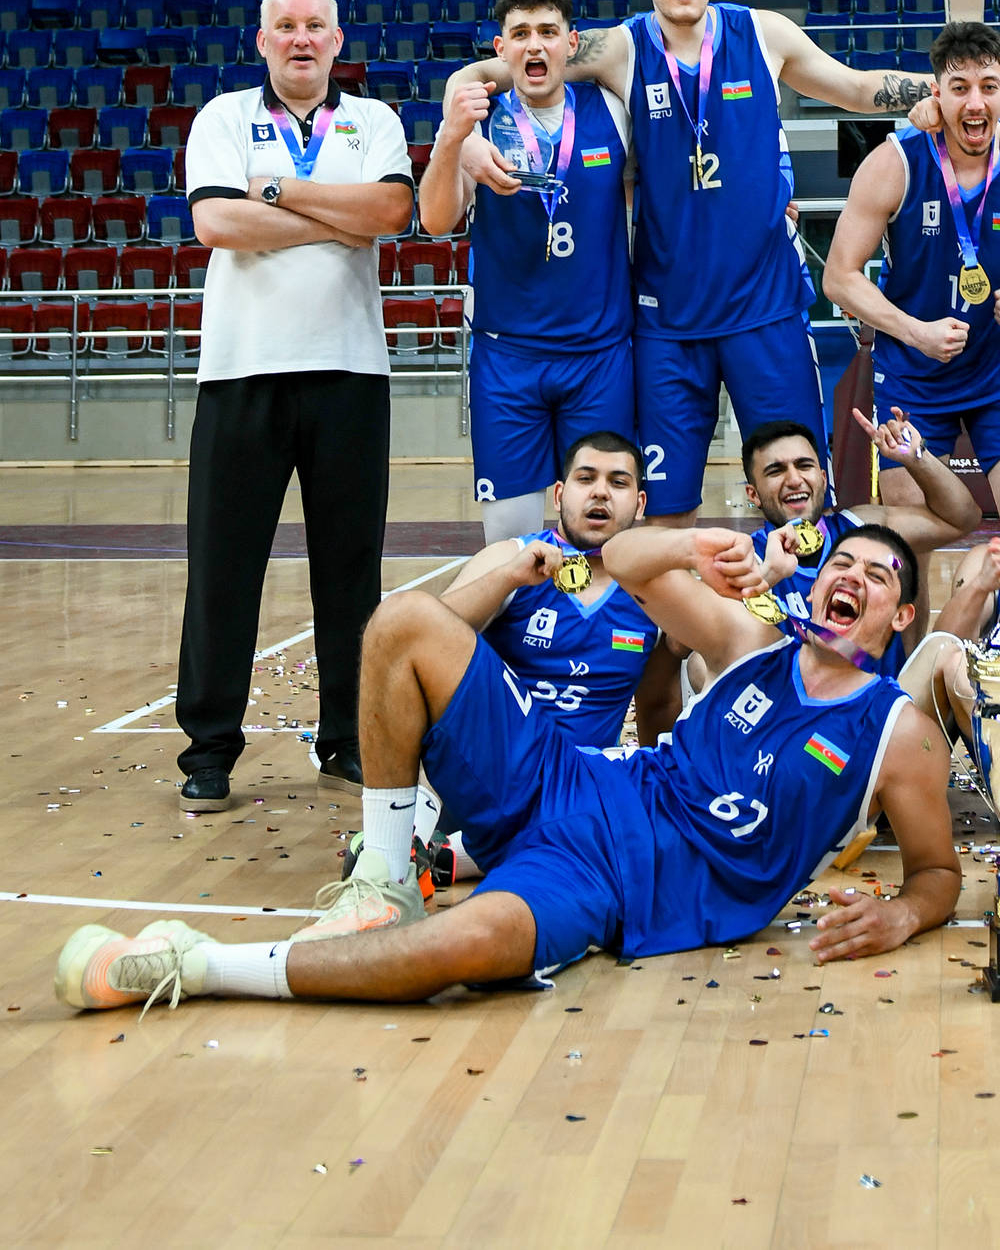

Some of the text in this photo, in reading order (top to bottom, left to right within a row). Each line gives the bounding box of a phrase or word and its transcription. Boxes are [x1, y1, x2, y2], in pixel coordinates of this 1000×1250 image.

[650, 108, 673, 120] AZTU
[688, 152, 723, 191] 12
[551, 221, 575, 258] 8
[922, 226, 941, 236] AZTU
[642, 444, 667, 481] 2
[950, 458, 980, 468] PAŞA S
[569, 568, 576, 584] 1
[522, 635, 551, 649] AZTU
[724, 711, 753, 735] AZTU
[708, 791, 769, 838] 67
